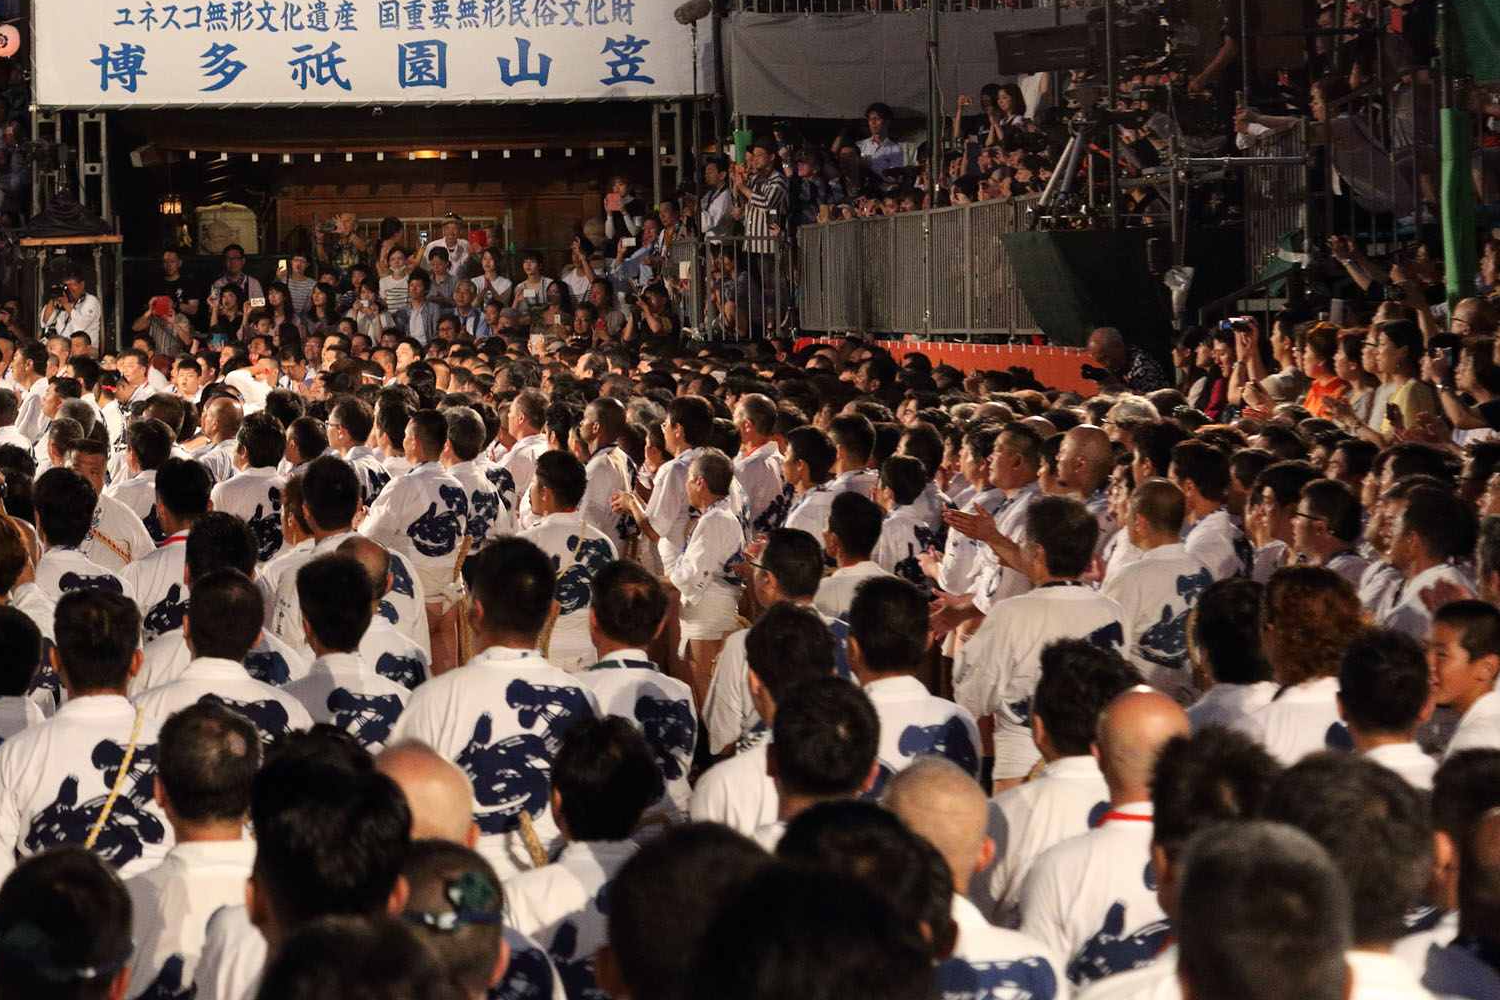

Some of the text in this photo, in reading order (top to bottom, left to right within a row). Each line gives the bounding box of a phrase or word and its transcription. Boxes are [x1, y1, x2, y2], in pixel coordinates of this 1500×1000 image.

[113, 0, 358, 33] ユネスコ無形文化遺産
[90, 33, 656, 93] 博多祇園山笠
